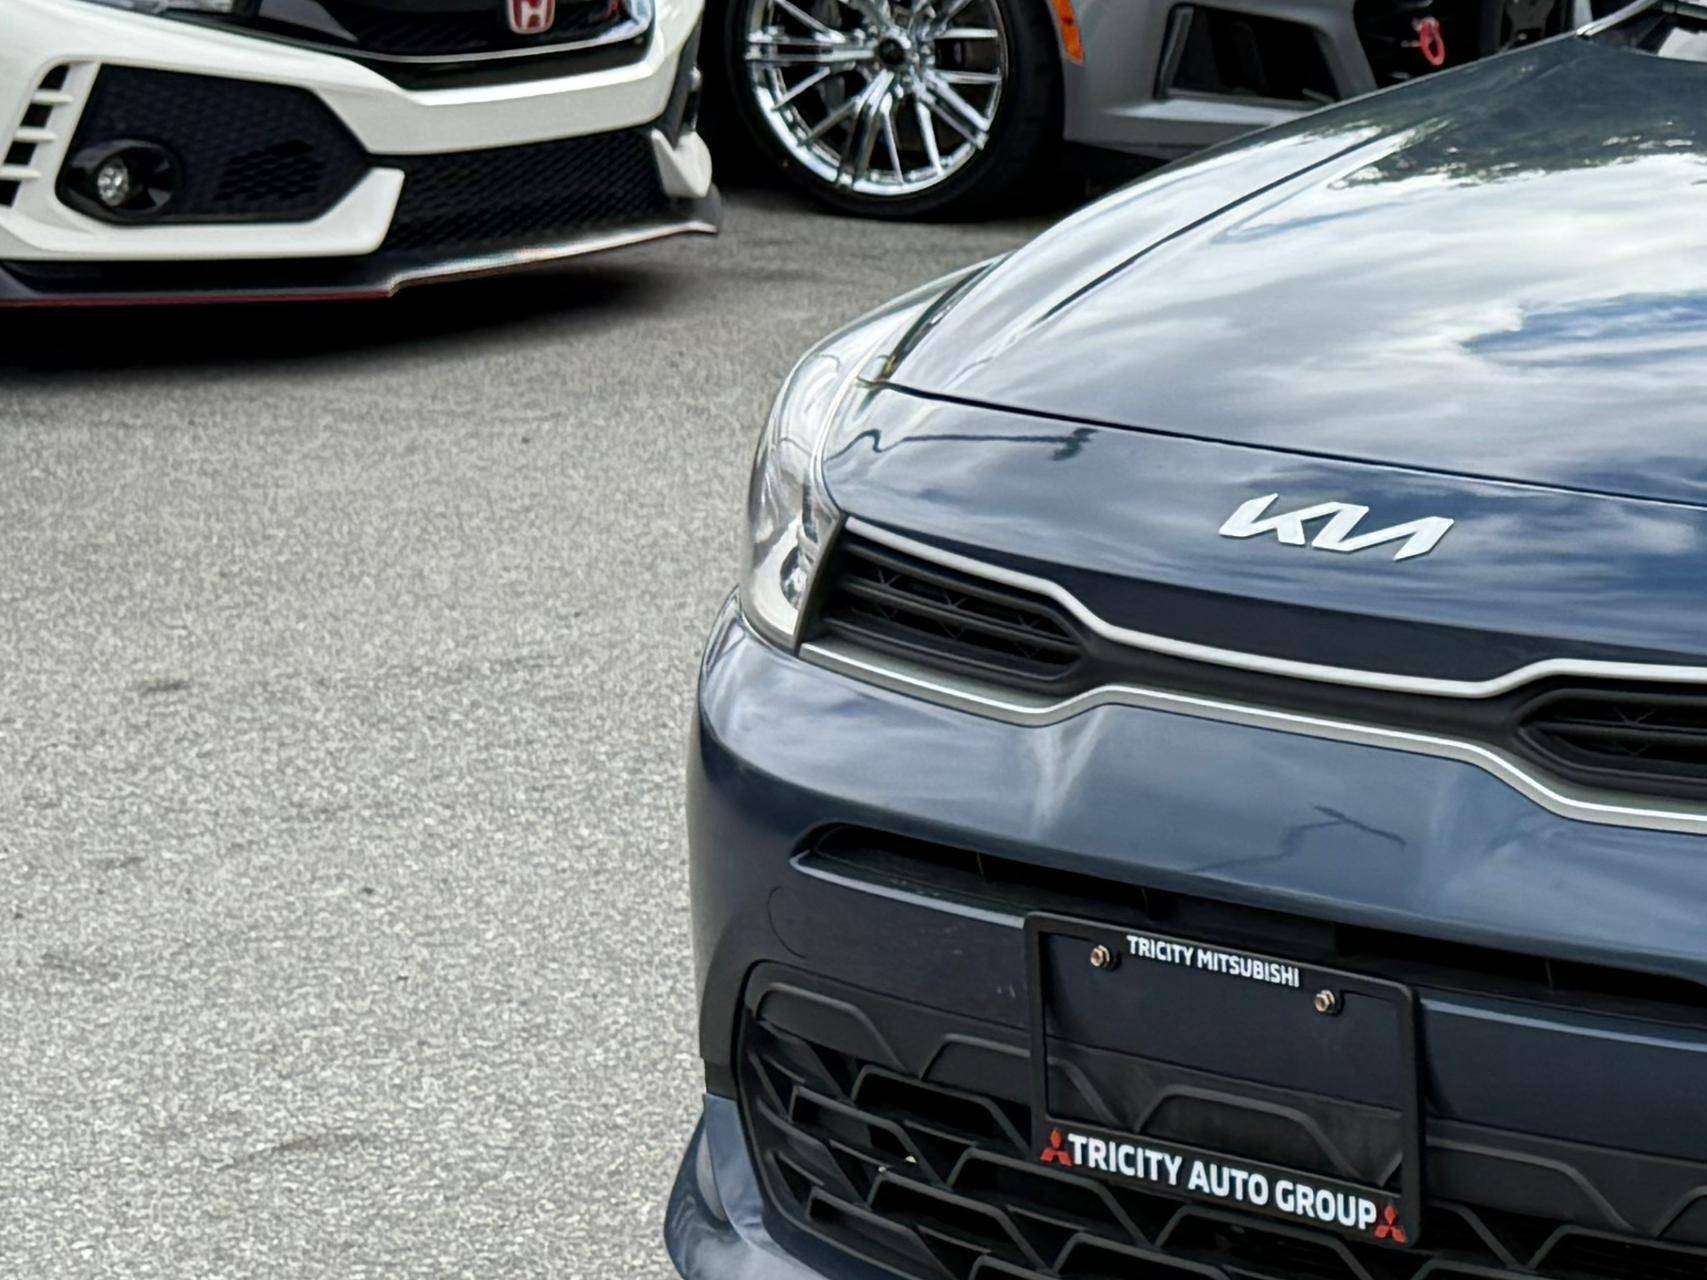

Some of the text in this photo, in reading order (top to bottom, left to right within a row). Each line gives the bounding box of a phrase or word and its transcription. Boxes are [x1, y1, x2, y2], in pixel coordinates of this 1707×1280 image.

[1219, 493, 1454, 561] KIA
[1126, 934, 1300, 988] TRICITY MITSUBISHI
[1067, 1133, 1377, 1230] TRICITY AUTO GROUP
